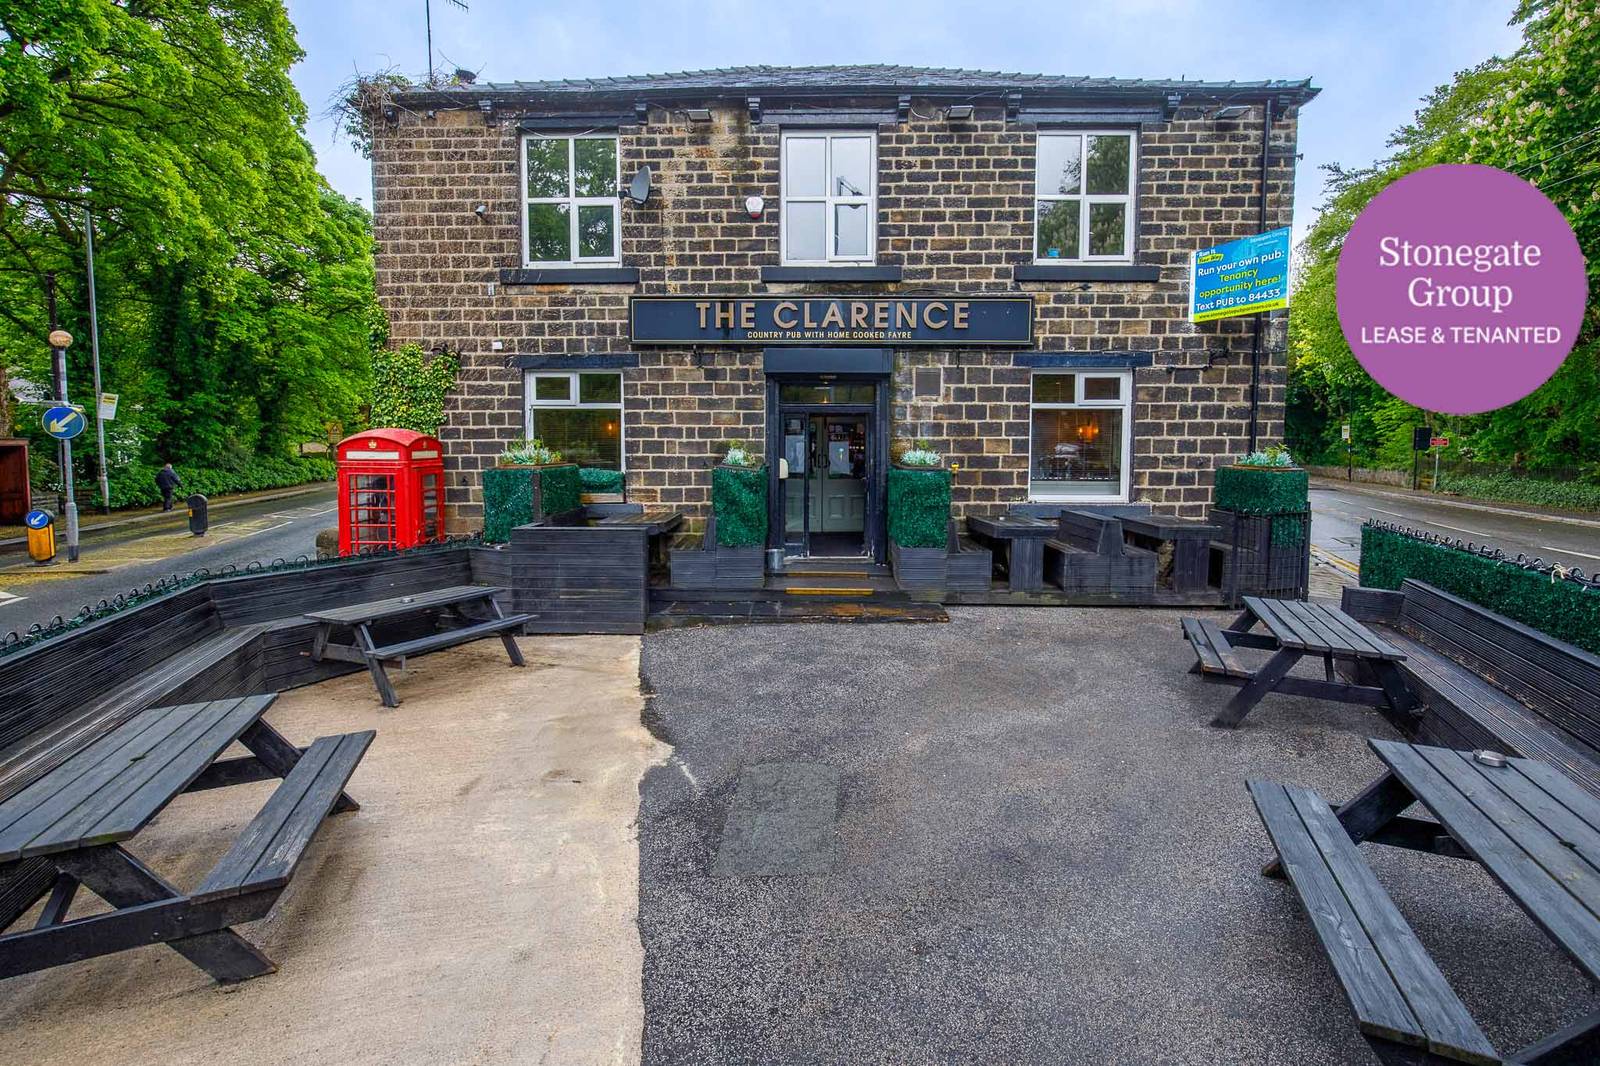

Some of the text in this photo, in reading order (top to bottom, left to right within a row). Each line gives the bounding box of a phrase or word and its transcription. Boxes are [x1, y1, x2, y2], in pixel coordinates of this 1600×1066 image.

[1198, 250, 1285, 276] Run your own pub:
[1199, 275, 1281, 298] opportunity here!
[1220, 268, 1258, 282] Tenancy
[1195, 288, 1281, 311] Text PUB to 84433
[696, 302, 971, 330] THE CLARENCE
[747, 331, 912, 339] COUNTRY PUB WITH HOME COOKED FAYRE
